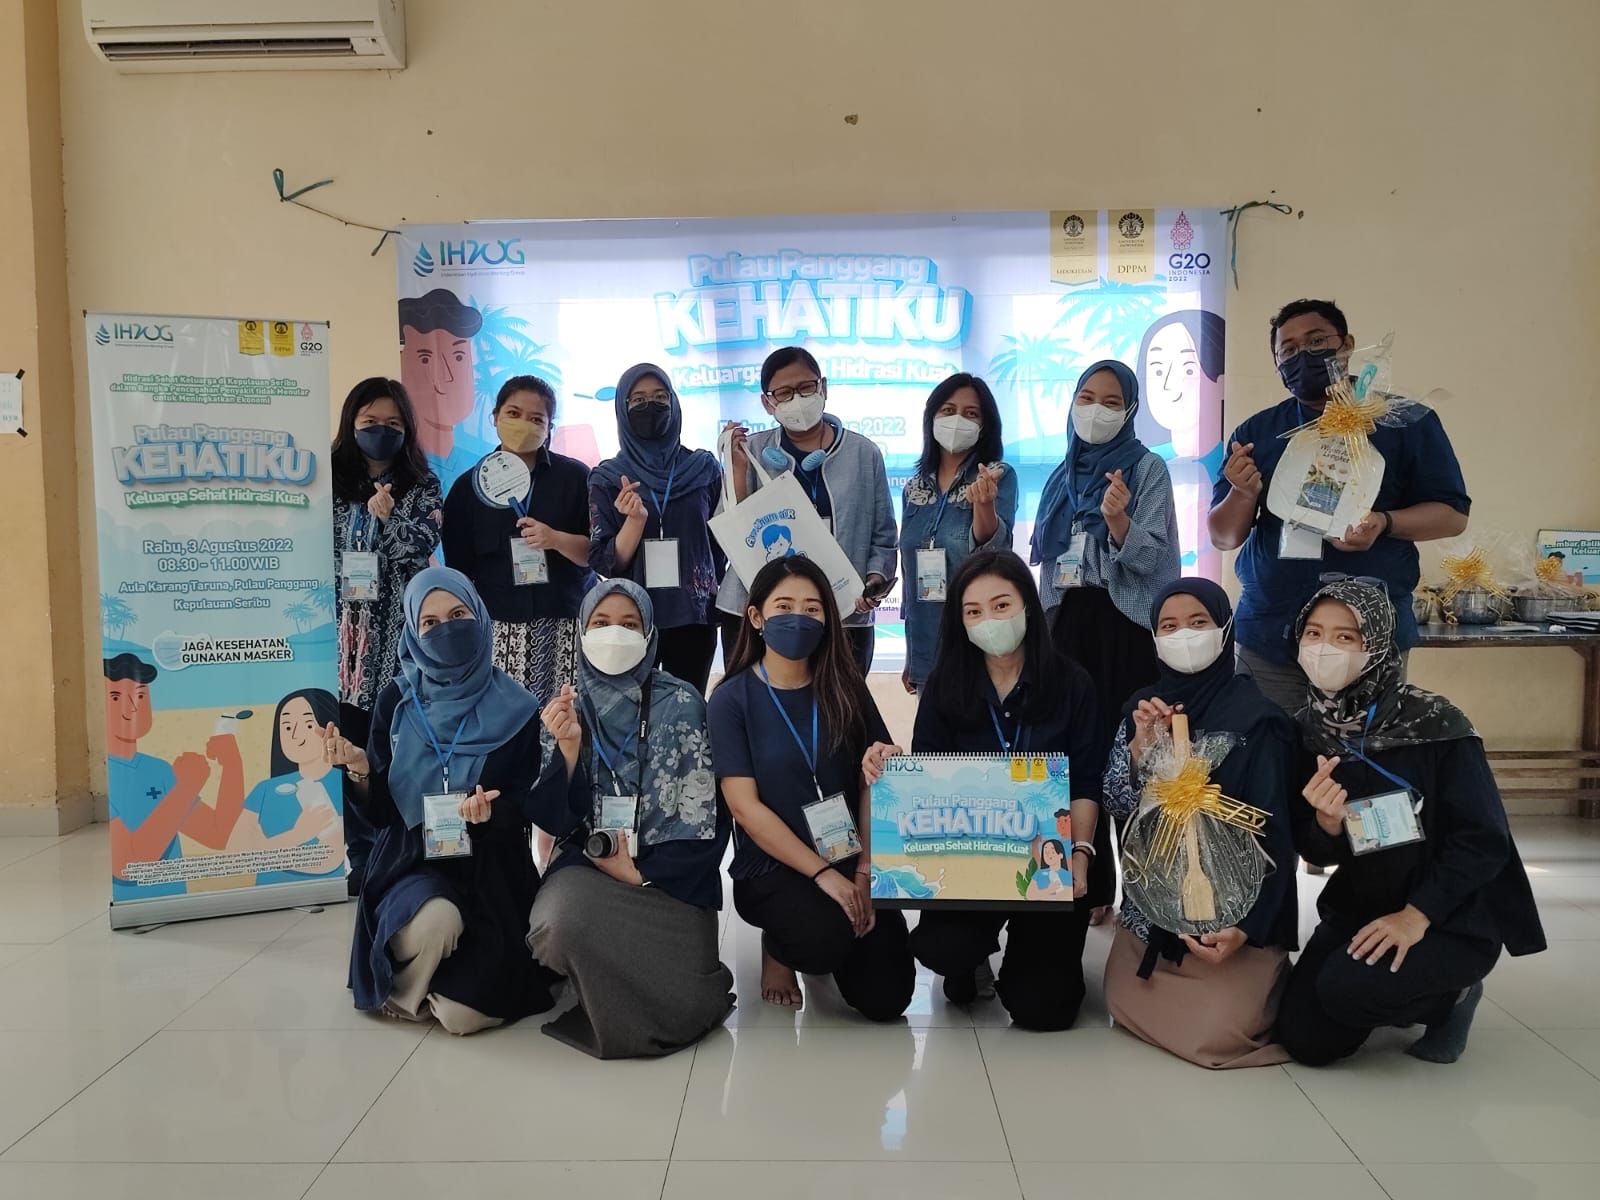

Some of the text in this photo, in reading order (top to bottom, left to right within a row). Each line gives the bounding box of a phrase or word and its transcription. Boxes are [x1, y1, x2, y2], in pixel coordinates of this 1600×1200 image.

[690, 249, 930, 284] Pulau Panggang
[1118, 265, 1147, 273] DPPM
[1169, 253, 1211, 269] G20
[654, 280, 970, 352] KEHATIKU
[300, 342, 323, 351] G20
[675, 366, 762, 388] Keluarga
[831, 358, 903, 379] Hidrasi
[133, 423, 291, 446] Pulau Panggang
[862, 417, 906, 436] 2022
[112, 444, 315, 485] KEHATIKU
[125, 488, 306, 508] Keluarga Sehat Hidrasi Kuat
[144, 538, 293, 555] Rabu, 3 Agustus 2022
[158, 558, 198, 572] 08.30
[210, 557, 248, 571] 11.00
[249, 557, 280, 570] WIB
[120, 579, 319, 595] Aula Karang Taruna, Pulau Panggang
[174, 598, 270, 611] Kepulauan Seribu
[182, 638, 289, 652] JAGA KESEHATAN,
[182, 650, 292, 664] GUNAKAN MASKER
[912, 794, 1018, 810] Pulau Panggang
[897, 808, 1037, 841] KEHATIKU
[903, 841, 1030, 855] Keluarga Sehat Hidrasi Kuat
